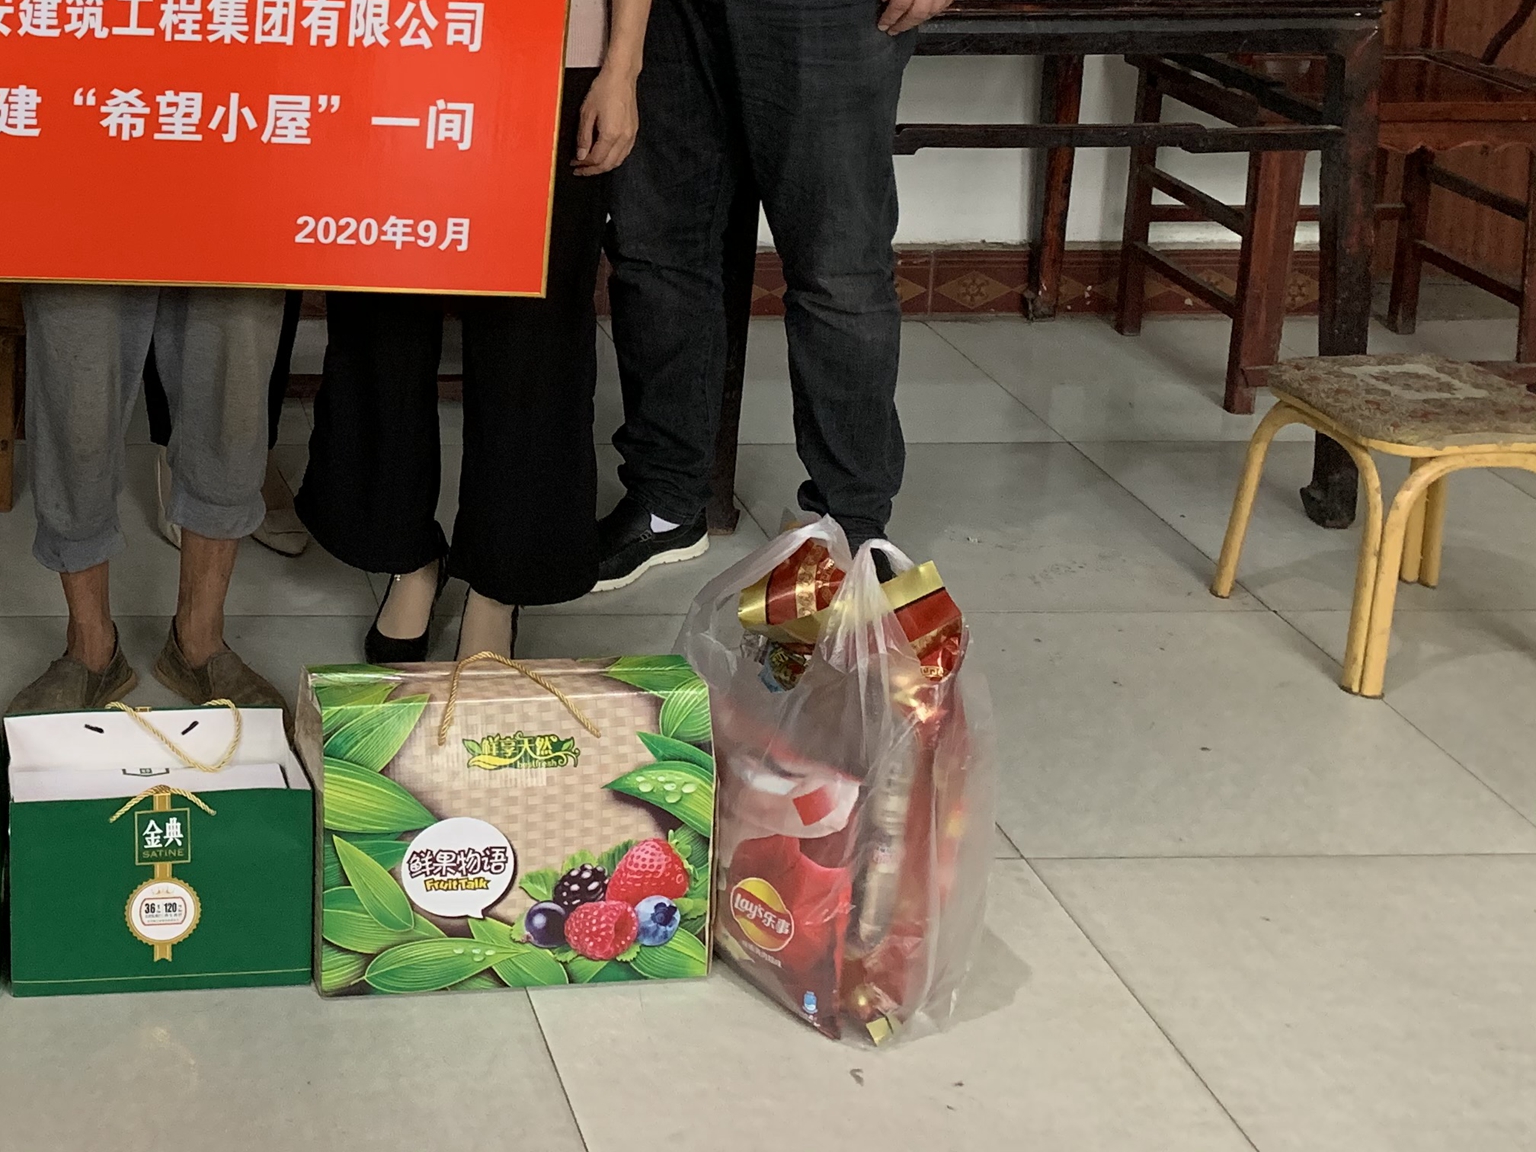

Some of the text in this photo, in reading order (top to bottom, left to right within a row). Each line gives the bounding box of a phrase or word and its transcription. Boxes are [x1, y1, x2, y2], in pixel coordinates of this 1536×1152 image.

[294, 215, 470, 252] 2020年9月
[142, 817, 184, 849] 金典
[407, 846, 509, 878] 鲜果物语
[424, 876, 491, 892] Fruit Talk
[734, 893, 791, 935] Lay's 乐事
